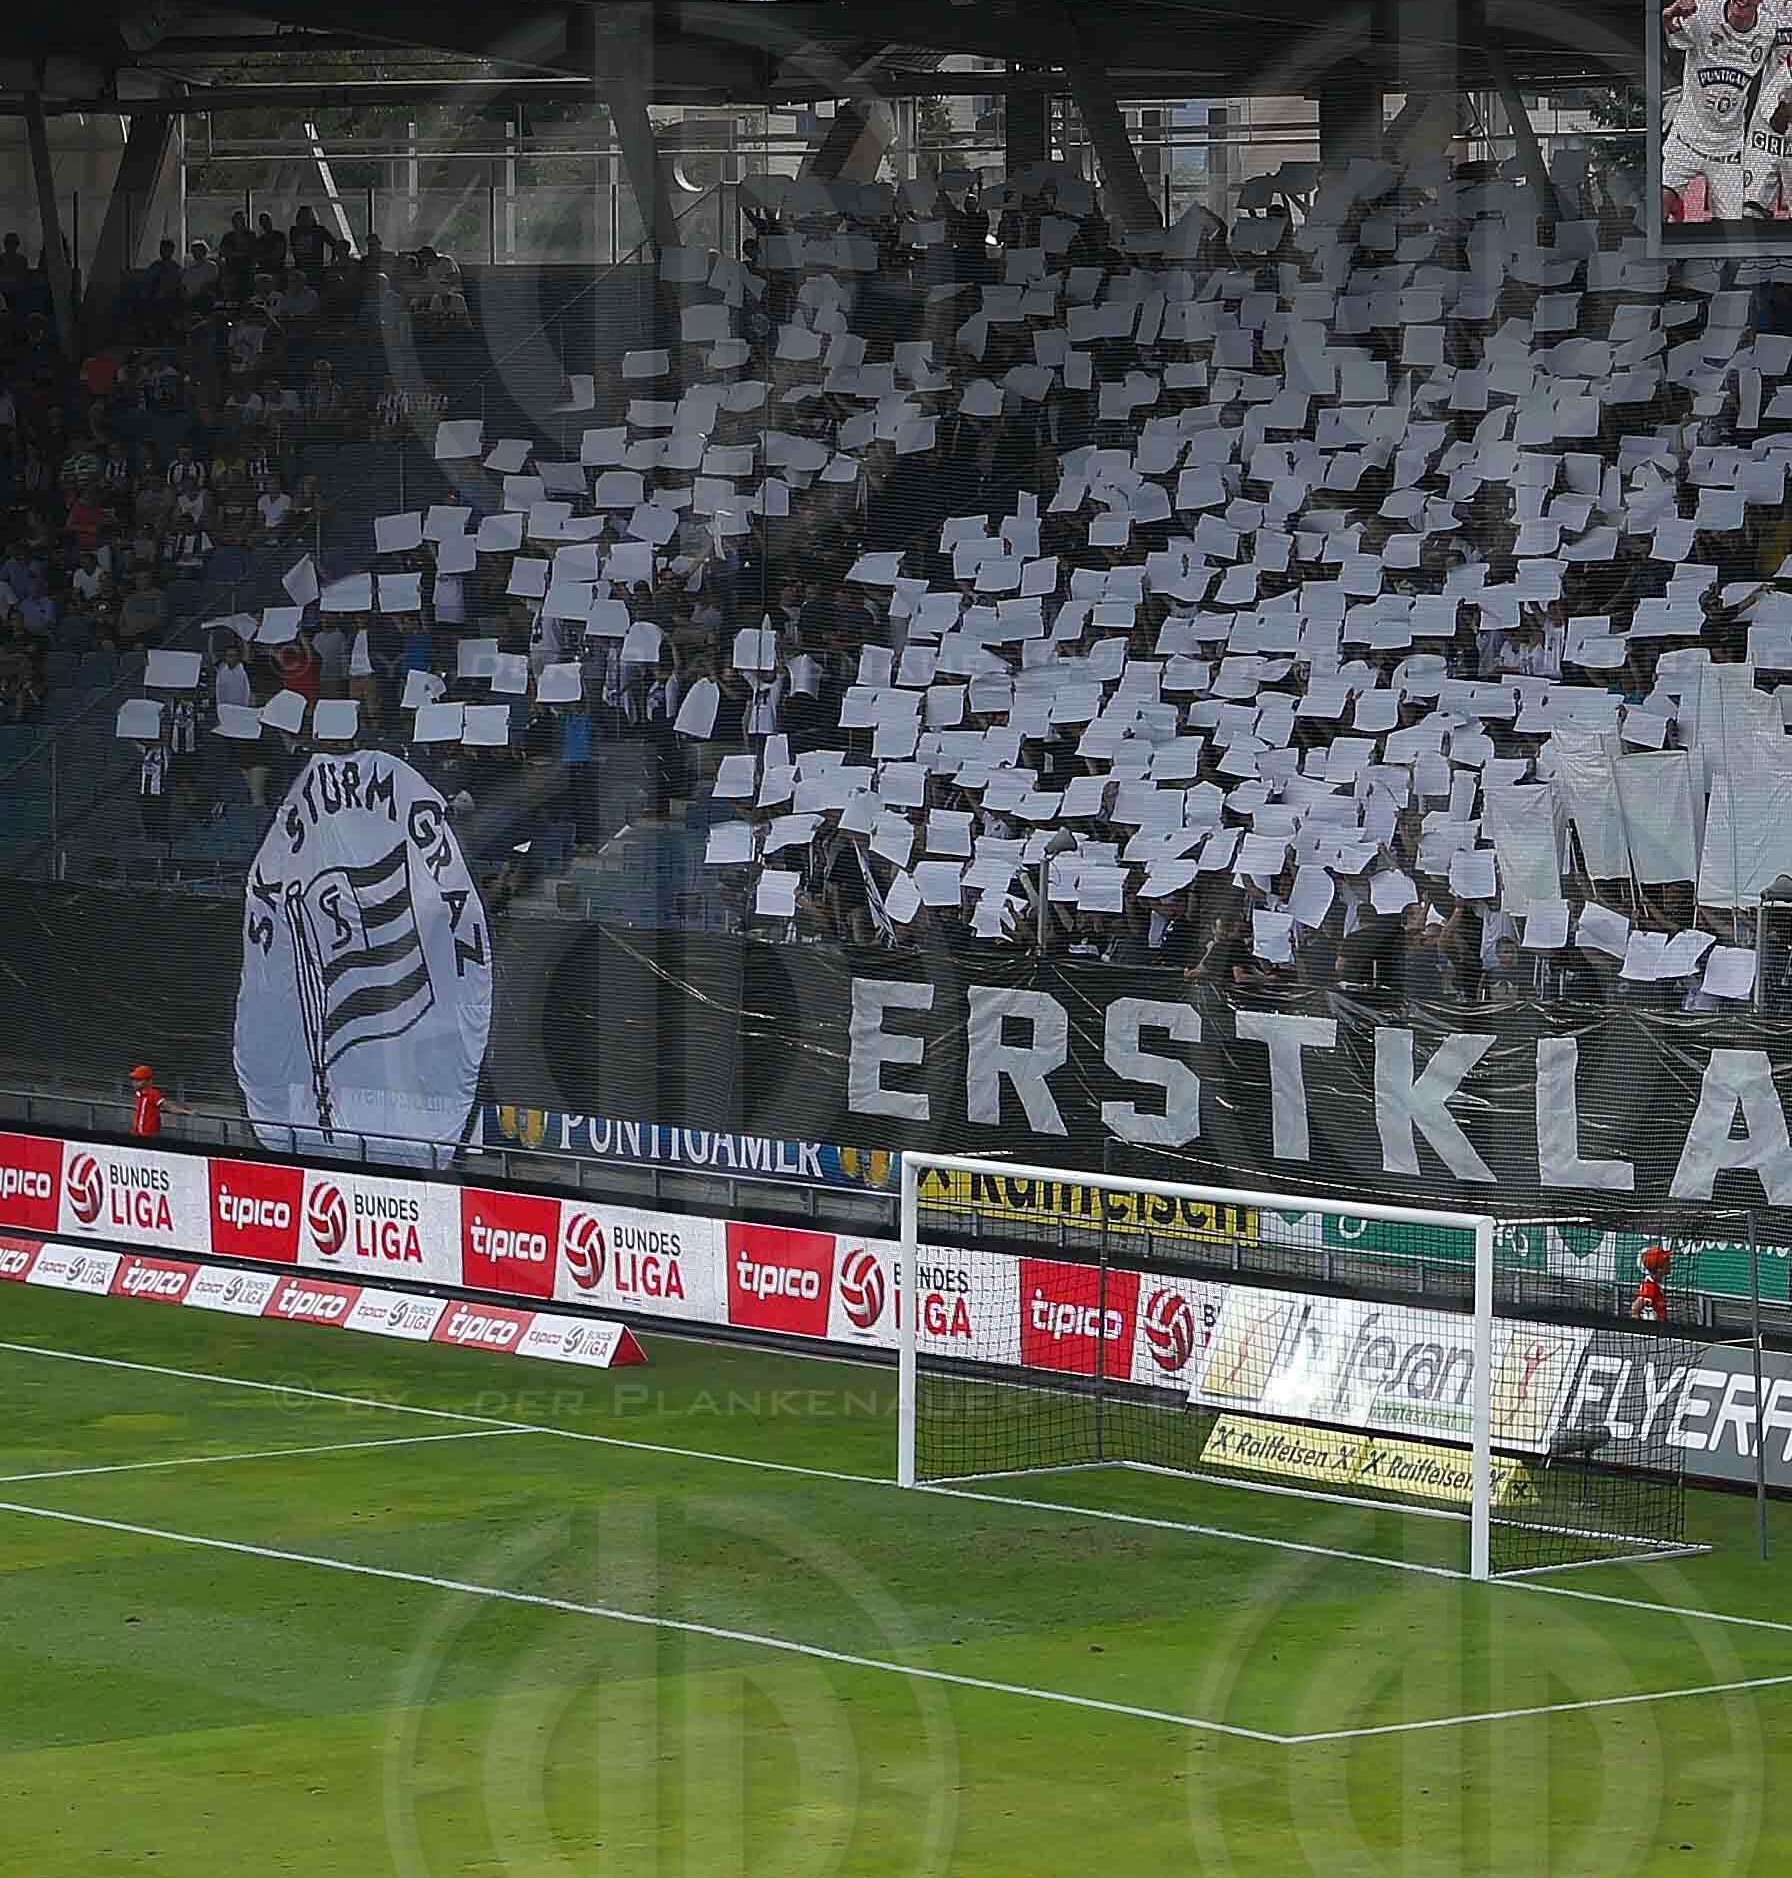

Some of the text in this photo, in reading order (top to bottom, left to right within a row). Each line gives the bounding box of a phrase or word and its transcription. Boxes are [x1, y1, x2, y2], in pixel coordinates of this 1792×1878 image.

[109, 1163, 170, 1192] BUNDES
[110, 1188, 174, 1232] LIGA
[217, 1184, 292, 1230] tipico
[354, 1193, 420, 1221] BUNDES
[355, 1218, 423, 1263] LIGA
[470, 1215, 548, 1263] tipico
[613, 1226, 681, 1257] BUNDES
[121, 1258, 188, 1296] tipico
[613, 1251, 686, 1300] LIGA
[736, 1250, 821, 1301] tipico
[894, 1263, 970, 1294] BNDES
[278, 1280, 348, 1319] tipico
[1030, 1288, 1124, 1340] tipico
[402, 1312, 431, 1332] LIGA
[447, 1304, 519, 1344] tipico
[579, 1338, 609, 1358] LIGA
